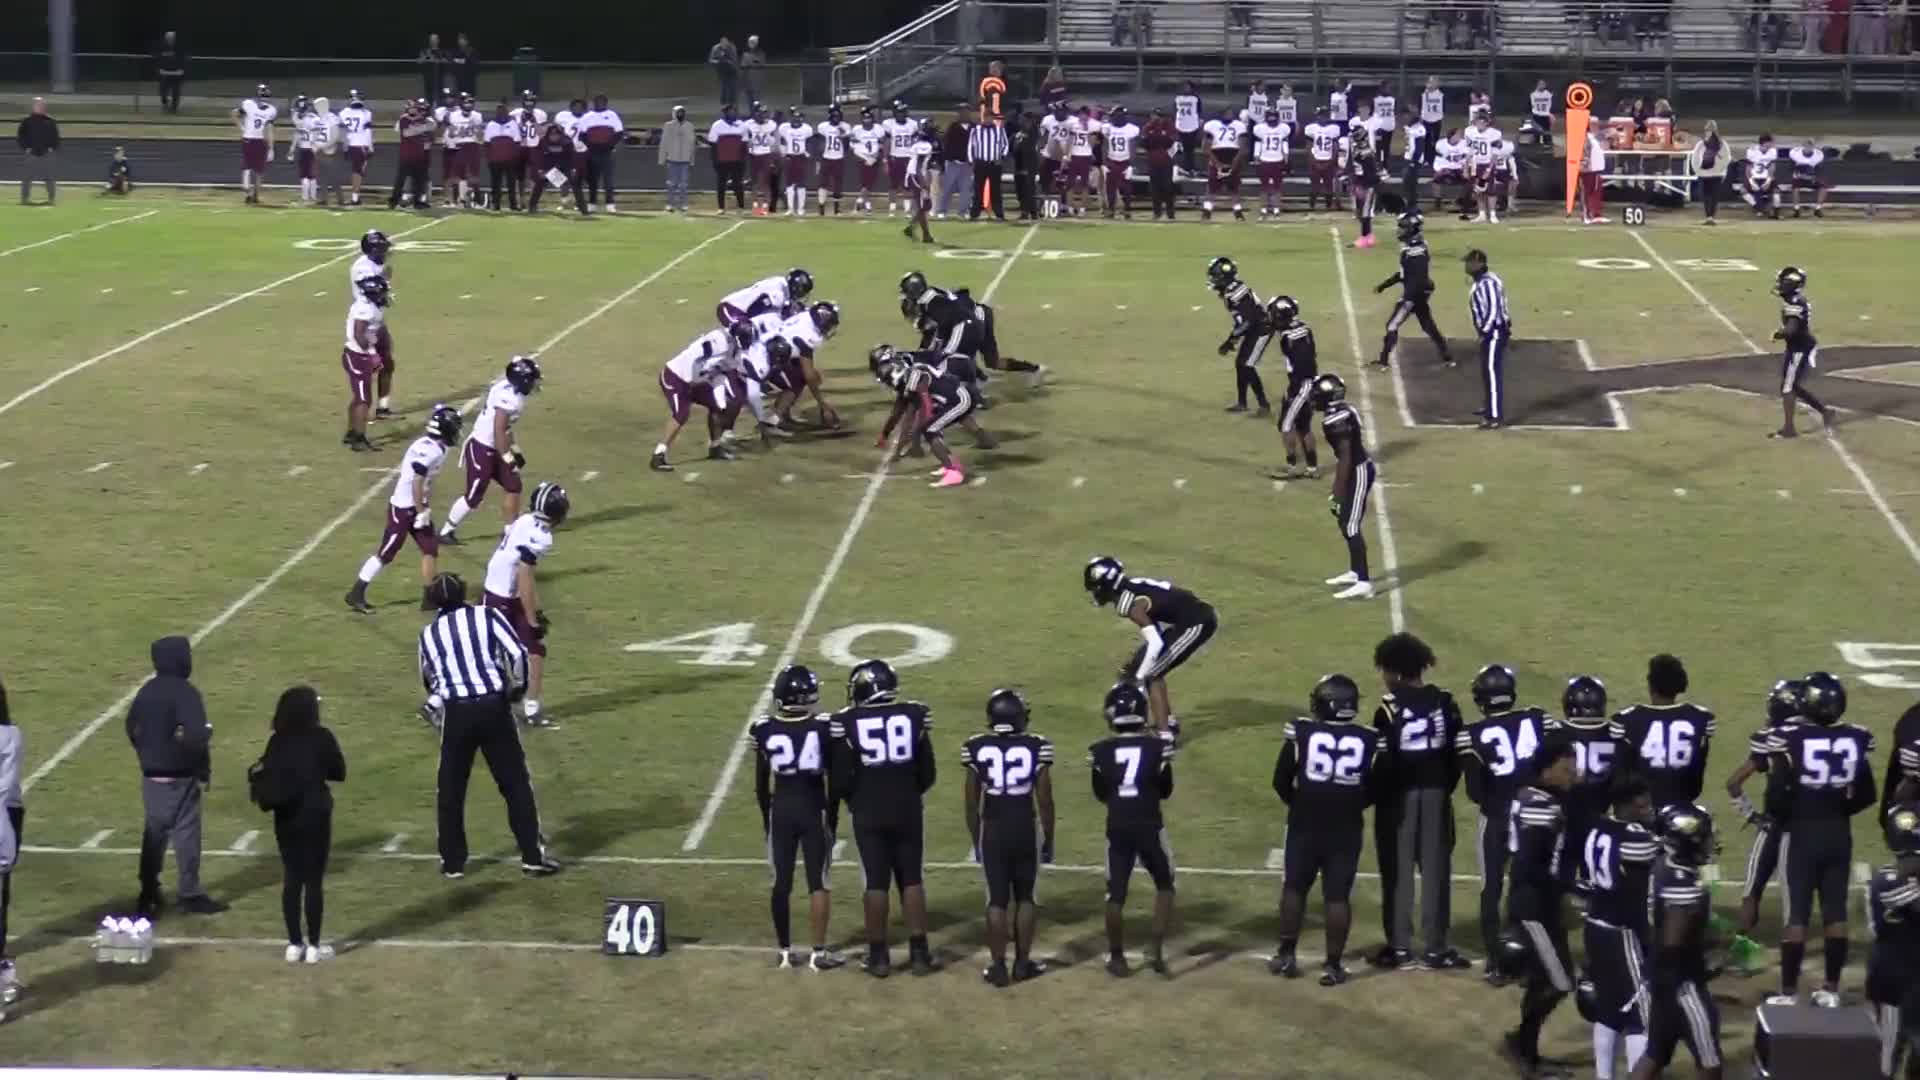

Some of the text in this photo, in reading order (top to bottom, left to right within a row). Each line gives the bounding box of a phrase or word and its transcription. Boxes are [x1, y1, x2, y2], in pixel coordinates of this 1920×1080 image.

[1219, 127, 1237, 142] 73
[1265, 136, 1280, 151] 13
[1624, 207, 1644, 225] 50
[623, 621, 956, 669] 40
[764, 730, 823, 774] 24
[855, 714, 914, 767] 58
[1305, 731, 1366, 786] 62
[1479, 717, 1540, 777] 34
[1639, 719, 1697, 769] 46
[1800, 736, 1860, 789] 53
[976, 744, 1034, 797] 32
[1114, 746, 1142, 798] 7
[606, 903, 656, 955] 40
